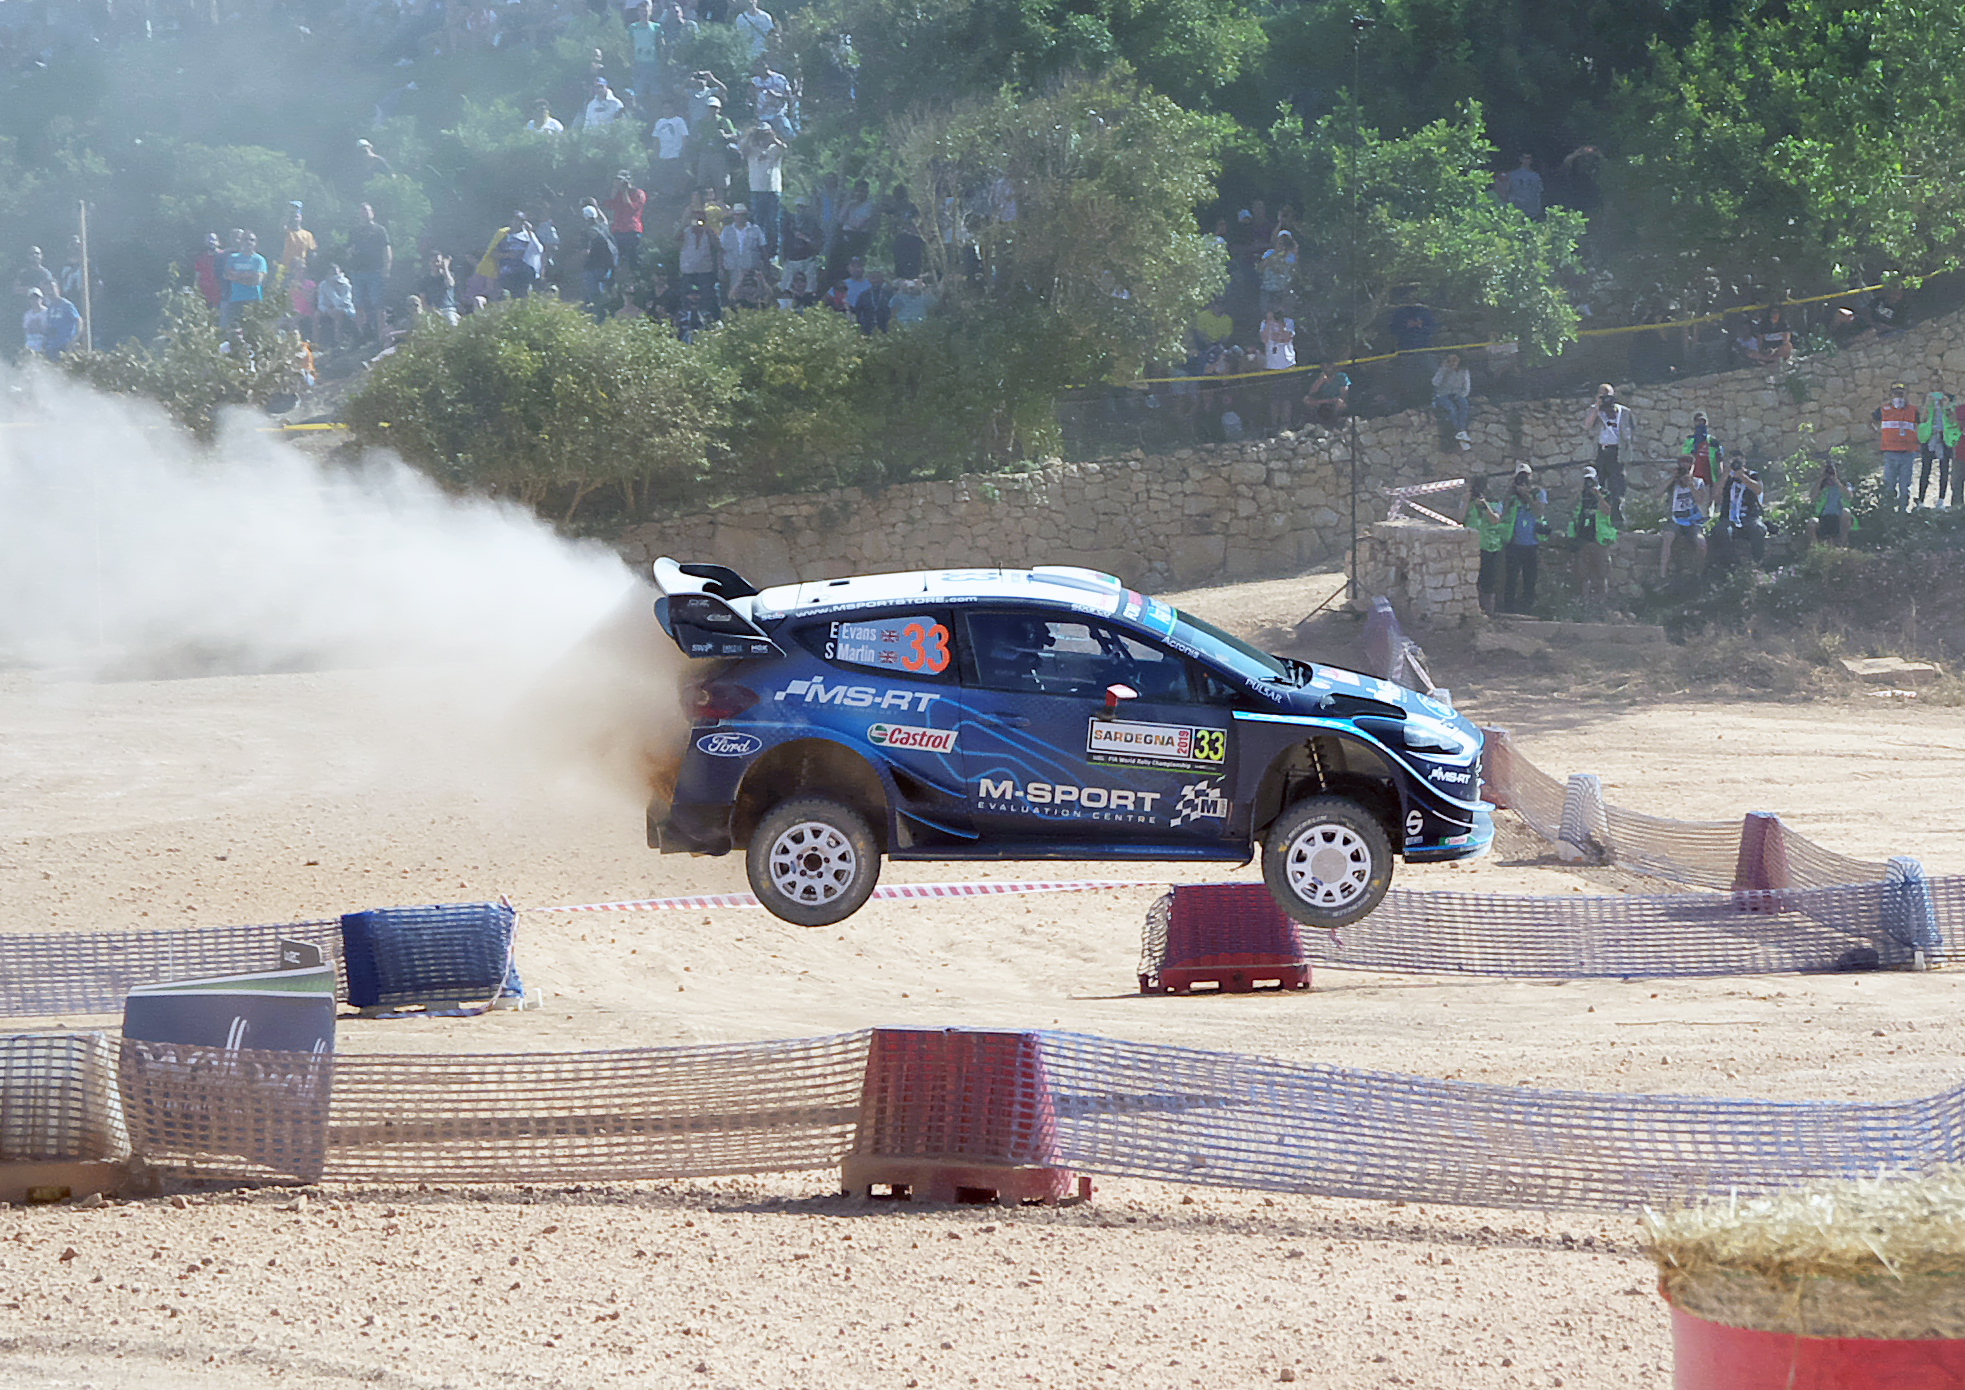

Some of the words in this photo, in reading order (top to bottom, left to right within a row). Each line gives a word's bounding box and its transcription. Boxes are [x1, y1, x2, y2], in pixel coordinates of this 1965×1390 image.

[829, 621, 840, 639] E
[841, 622, 877, 642] Evans
[824, 642, 835, 660] S
[837, 643, 875, 663] Martin
[902, 623, 952, 673] 33
[1161, 635, 1200, 659] Acronis
[804, 682, 941, 712] MS-RT
[1244, 678, 1283, 704] PULSAR
[707, 735, 751, 753] Ford
[888, 727, 950, 750] Castrol
[1093, 729, 1175, 747] SARDEGNA
[1177, 730, 1190, 754] 2019
[1194, 729, 1225, 761] 33
[1119, 756, 1136, 764] World
[1137, 758, 1151, 767] Rally
[1152, 759, 1191, 770] Championship
[978, 778, 1161, 812] M-SPORT
[978, 802, 1081, 818] EVALUATION
[1092, 811, 1156, 825] CENTRE
